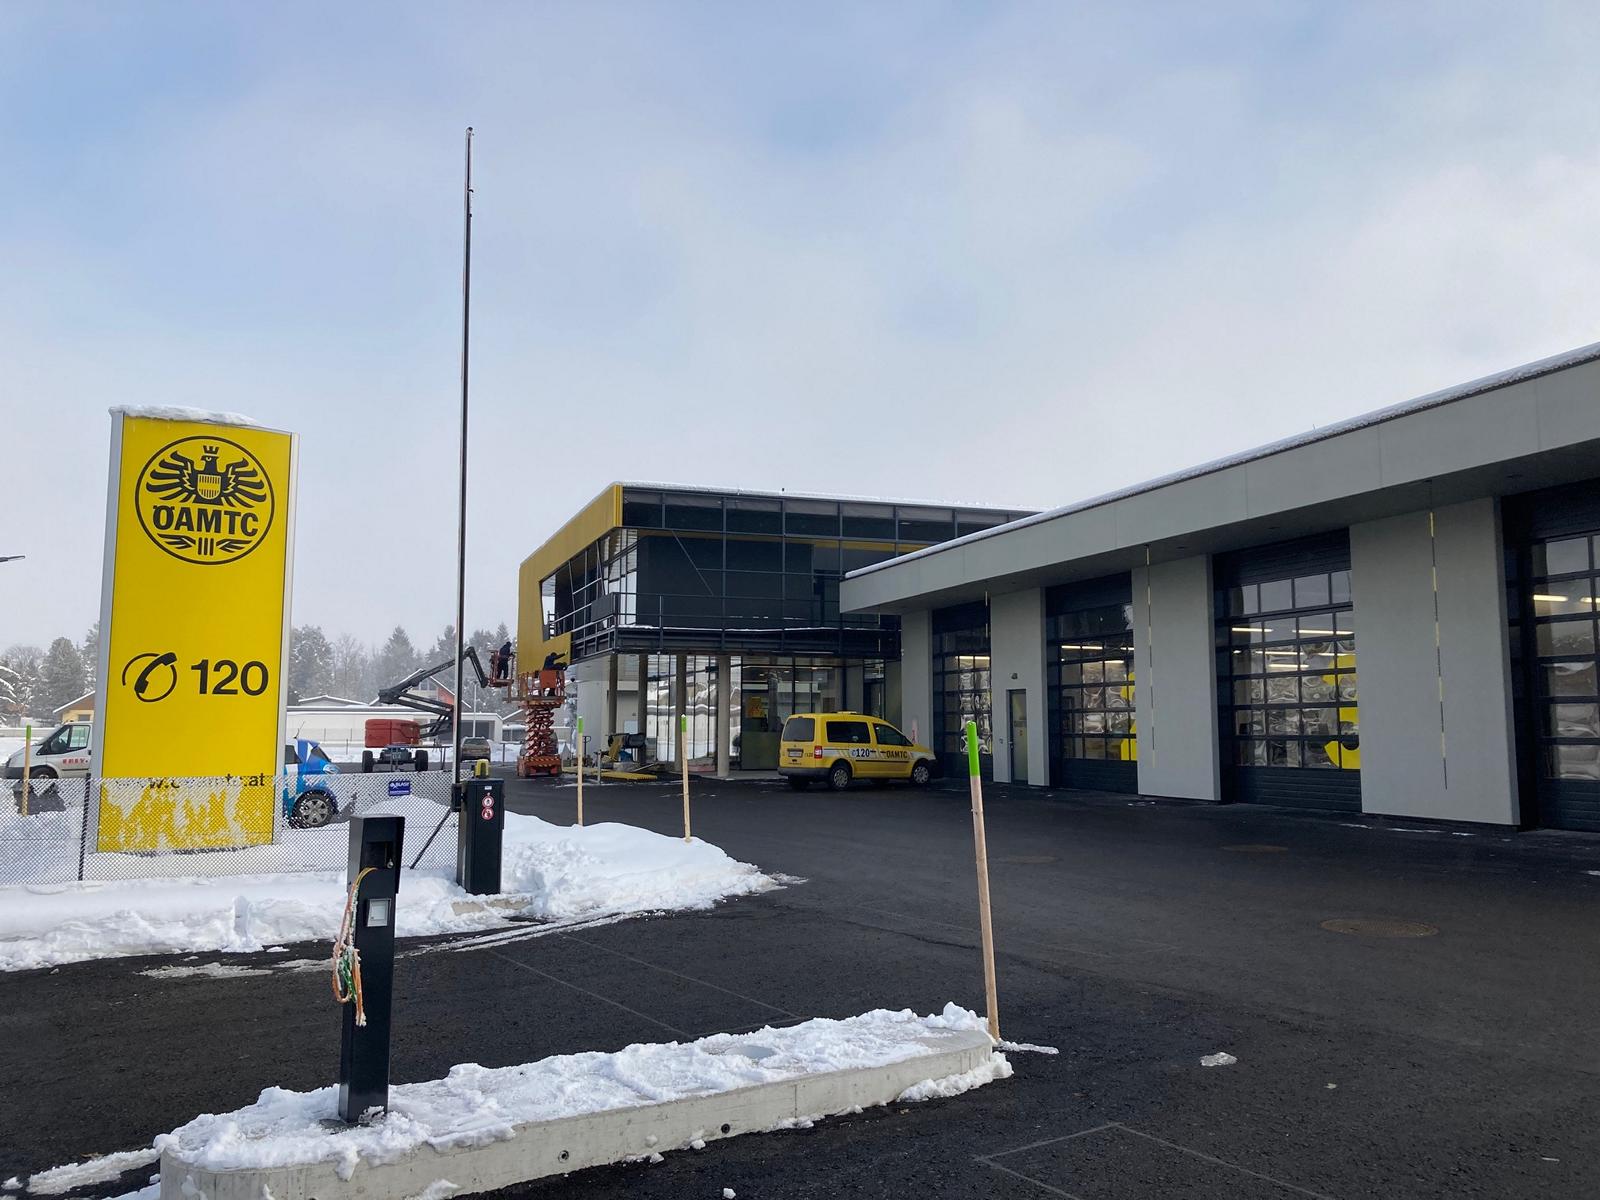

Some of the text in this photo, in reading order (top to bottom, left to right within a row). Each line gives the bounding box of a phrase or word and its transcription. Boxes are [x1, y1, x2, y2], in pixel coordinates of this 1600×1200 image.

[152, 505, 259, 537] ÖAMTC
[191, 659, 269, 696] 120
[856, 748, 870, 758] 120
